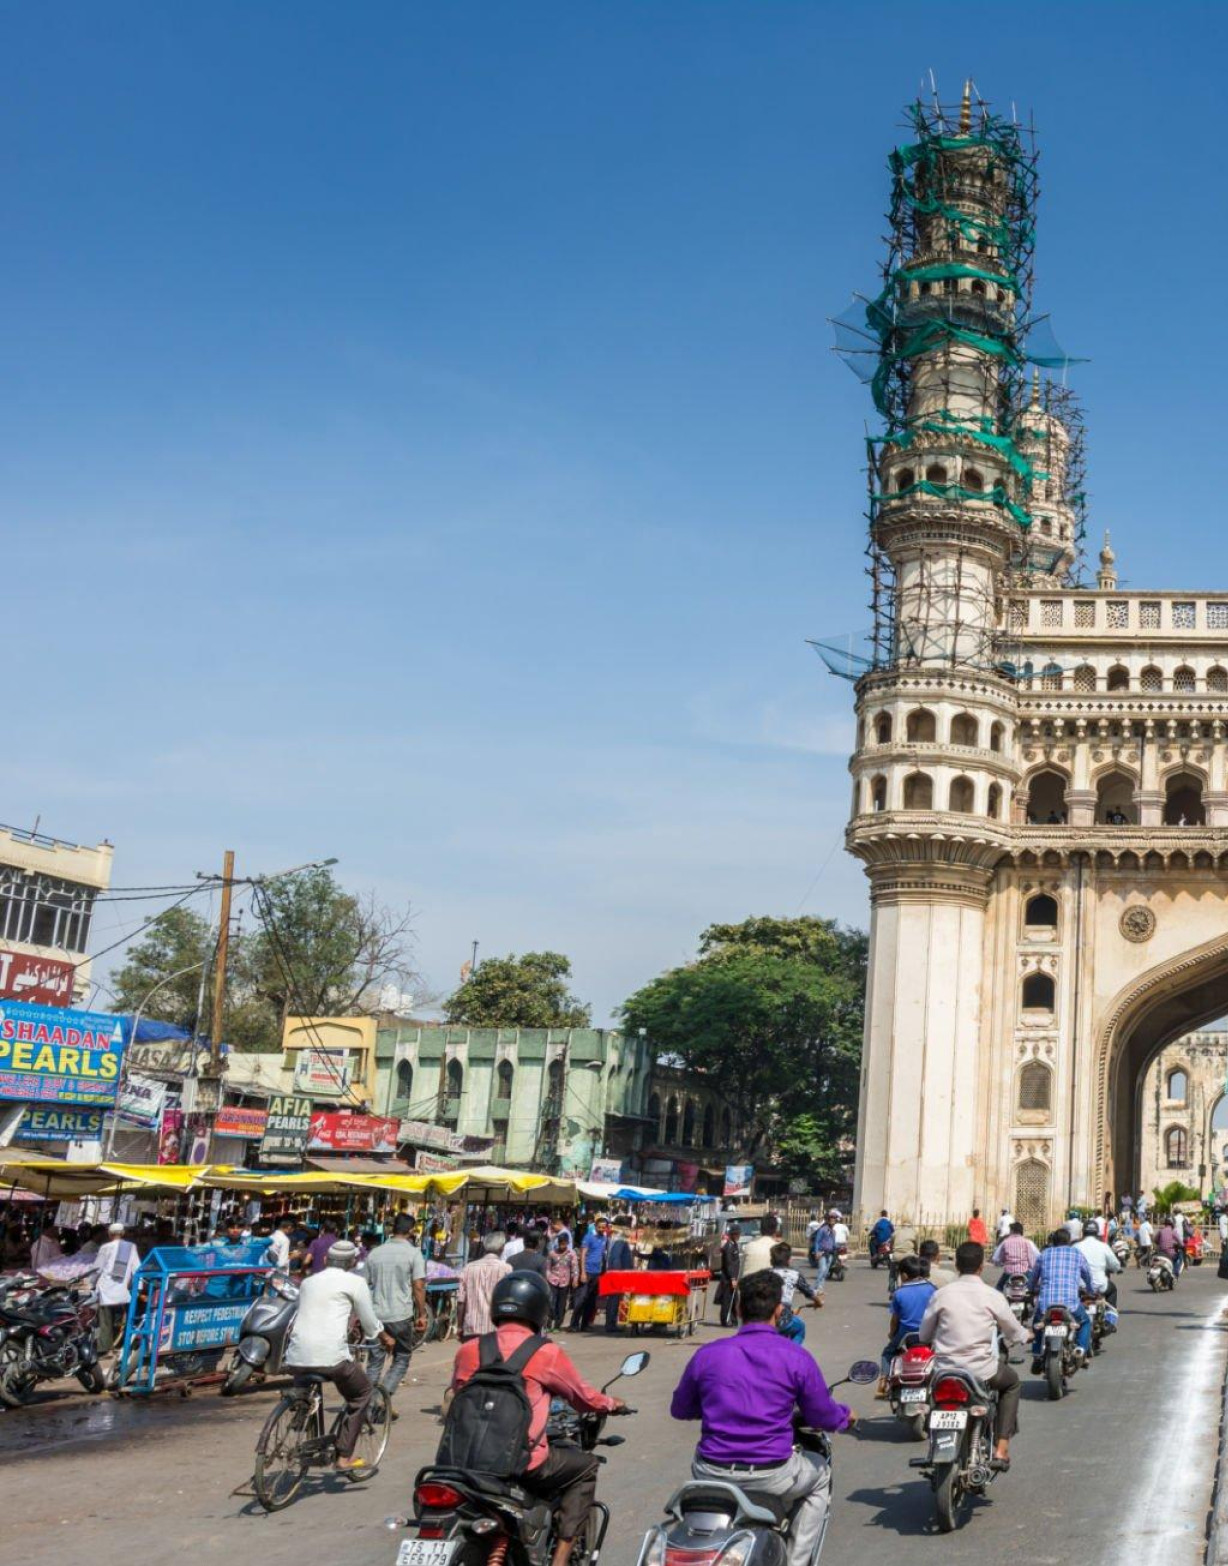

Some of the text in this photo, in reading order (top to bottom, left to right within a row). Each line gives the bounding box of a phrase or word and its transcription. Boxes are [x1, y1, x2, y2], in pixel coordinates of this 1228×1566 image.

[269, 1097, 312, 1117] AFIA
[19, 1110, 100, 1131] PEARLS
[266, 1115, 311, 1131] PEARLS
[184, 1309, 213, 1324] RESPECT
[178, 1331, 195, 1346] STOP
[409, 1541, 446, 1554] TS 11
